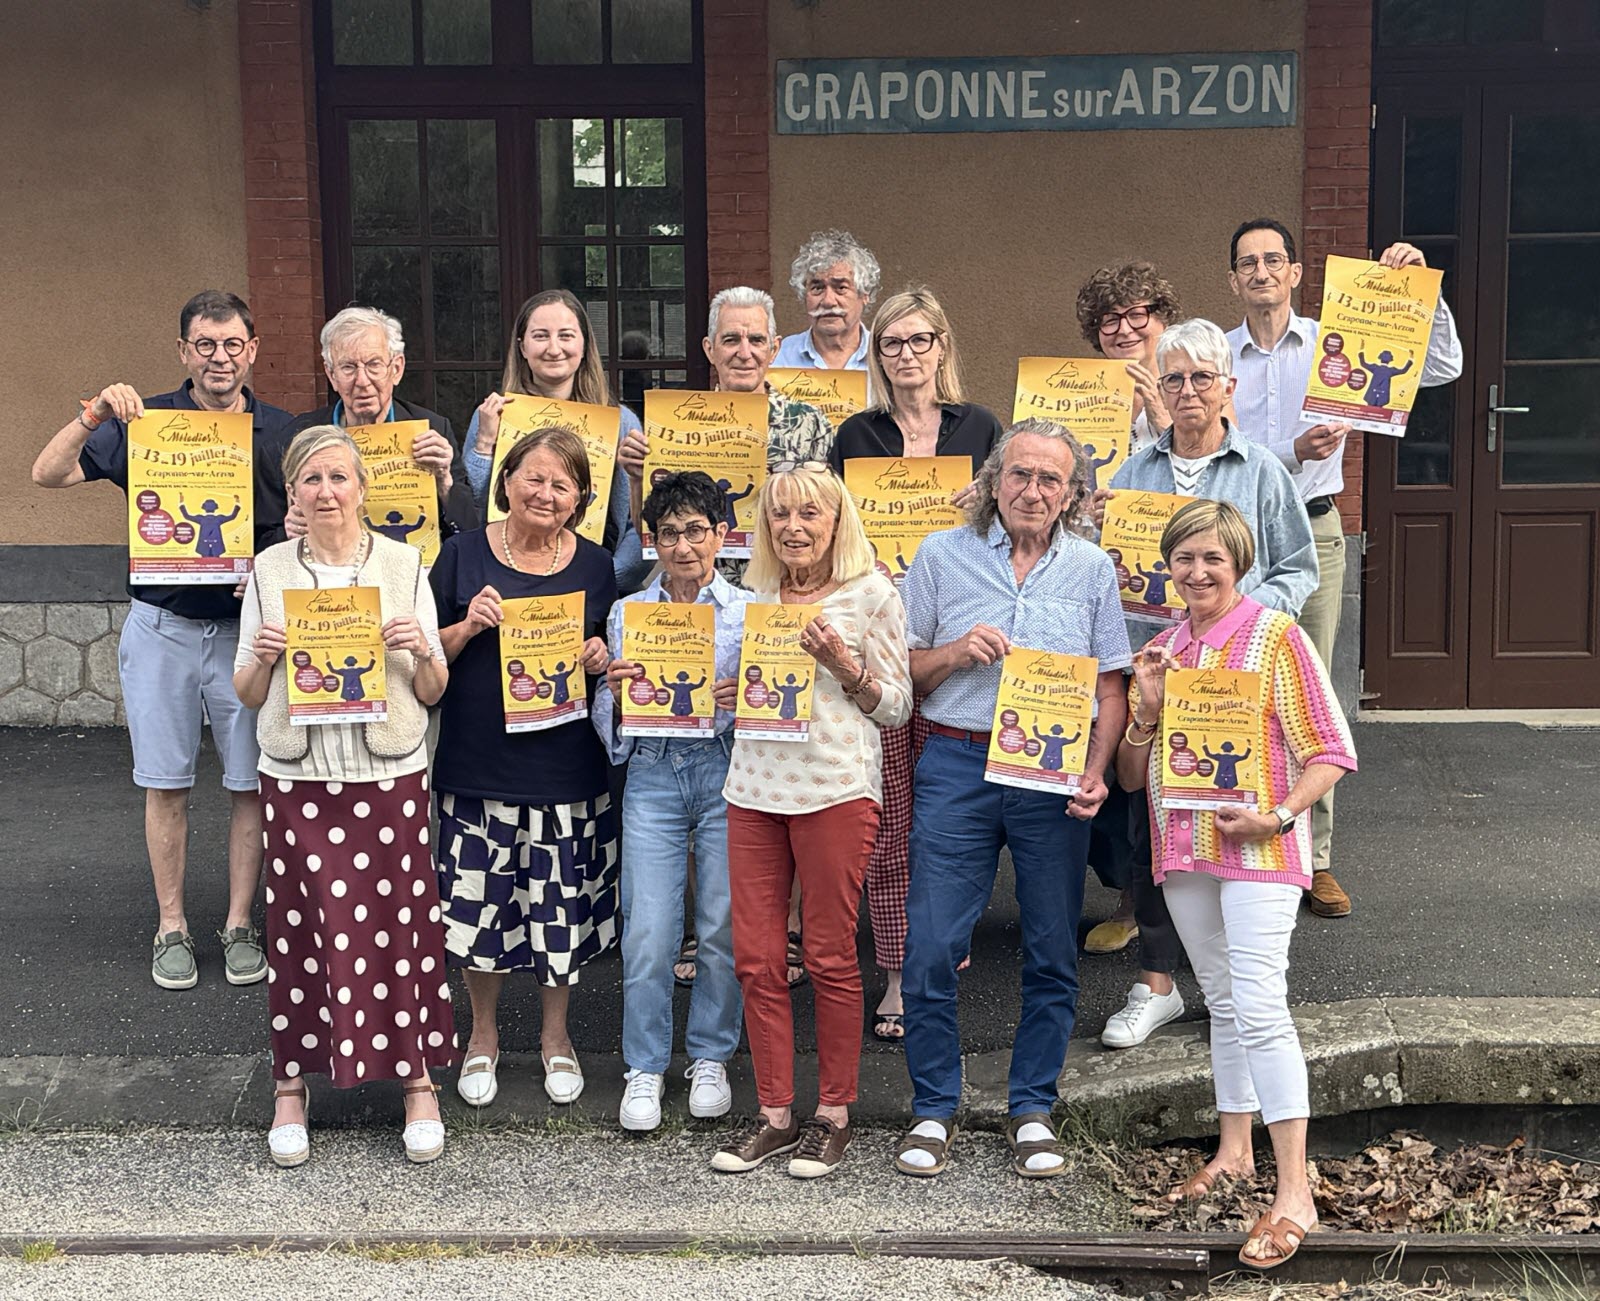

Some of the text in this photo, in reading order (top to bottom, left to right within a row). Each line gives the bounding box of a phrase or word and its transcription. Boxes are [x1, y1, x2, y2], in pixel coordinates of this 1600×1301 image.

[784, 64, 1291, 121] CRAPONNE sur ARZON
[1337, 293, 1353, 308] 13
[1361, 300, 1376, 314] 19
[1378, 298, 1412, 317] juillet
[1337, 313, 1415, 333] Craponne-sur-Arzon
[819, 403, 844, 414] illet
[1030, 394, 1046, 408] 13
[1056, 398, 1071, 412] 19
[1075, 396, 1110, 413] juillet
[683, 410, 727, 422] Mélodies
[168, 431, 212, 443] Mélodies
[658, 426, 675, 442] 13
[686, 431, 701, 446] 19
[704, 429, 742, 447] juillet
[144, 448, 160, 463] 13
[171, 452, 187, 466] 19
[190, 448, 226, 466] juillet
[361, 445, 393, 457] lodies
[660, 447, 750, 459] Craponne-sur-Arzon
[146, 469, 235, 479] Craponne-sur-Arzon
[372, 460, 409, 481] juillet
[369, 481, 418, 491] -sur-Arzon
[884, 479, 930, 490] Mélodies
[860, 498, 877, 512] 13
[888, 500, 904, 514] 19
[908, 496, 946, 515] juillet
[862, 519, 955, 529] Craponne-sur-Arzon
[1114, 517, 1127, 529] 13
[1135, 522, 1147, 533] 19
[296, 618, 309, 630] 13
[318, 620, 330, 631] 19
[333, 616, 362, 632] juillet
[511, 628, 523, 639] 13
[530, 628, 542, 640] 19
[545, 622, 570, 639] juillet
[634, 631, 646, 643] 13
[654, 634, 666, 645] 19
[669, 632, 697, 646] juillet
[754, 632, 766, 645] 13
[772, 636, 782, 647] 19
[1011, 677, 1026, 690] 13
[1033, 684, 1046, 696] 19
[1048, 684, 1079, 696] juillet
[1176, 698, 1189, 711] 13
[1198, 702, 1211, 713] 19
[1214, 700, 1243, 714] juillet
